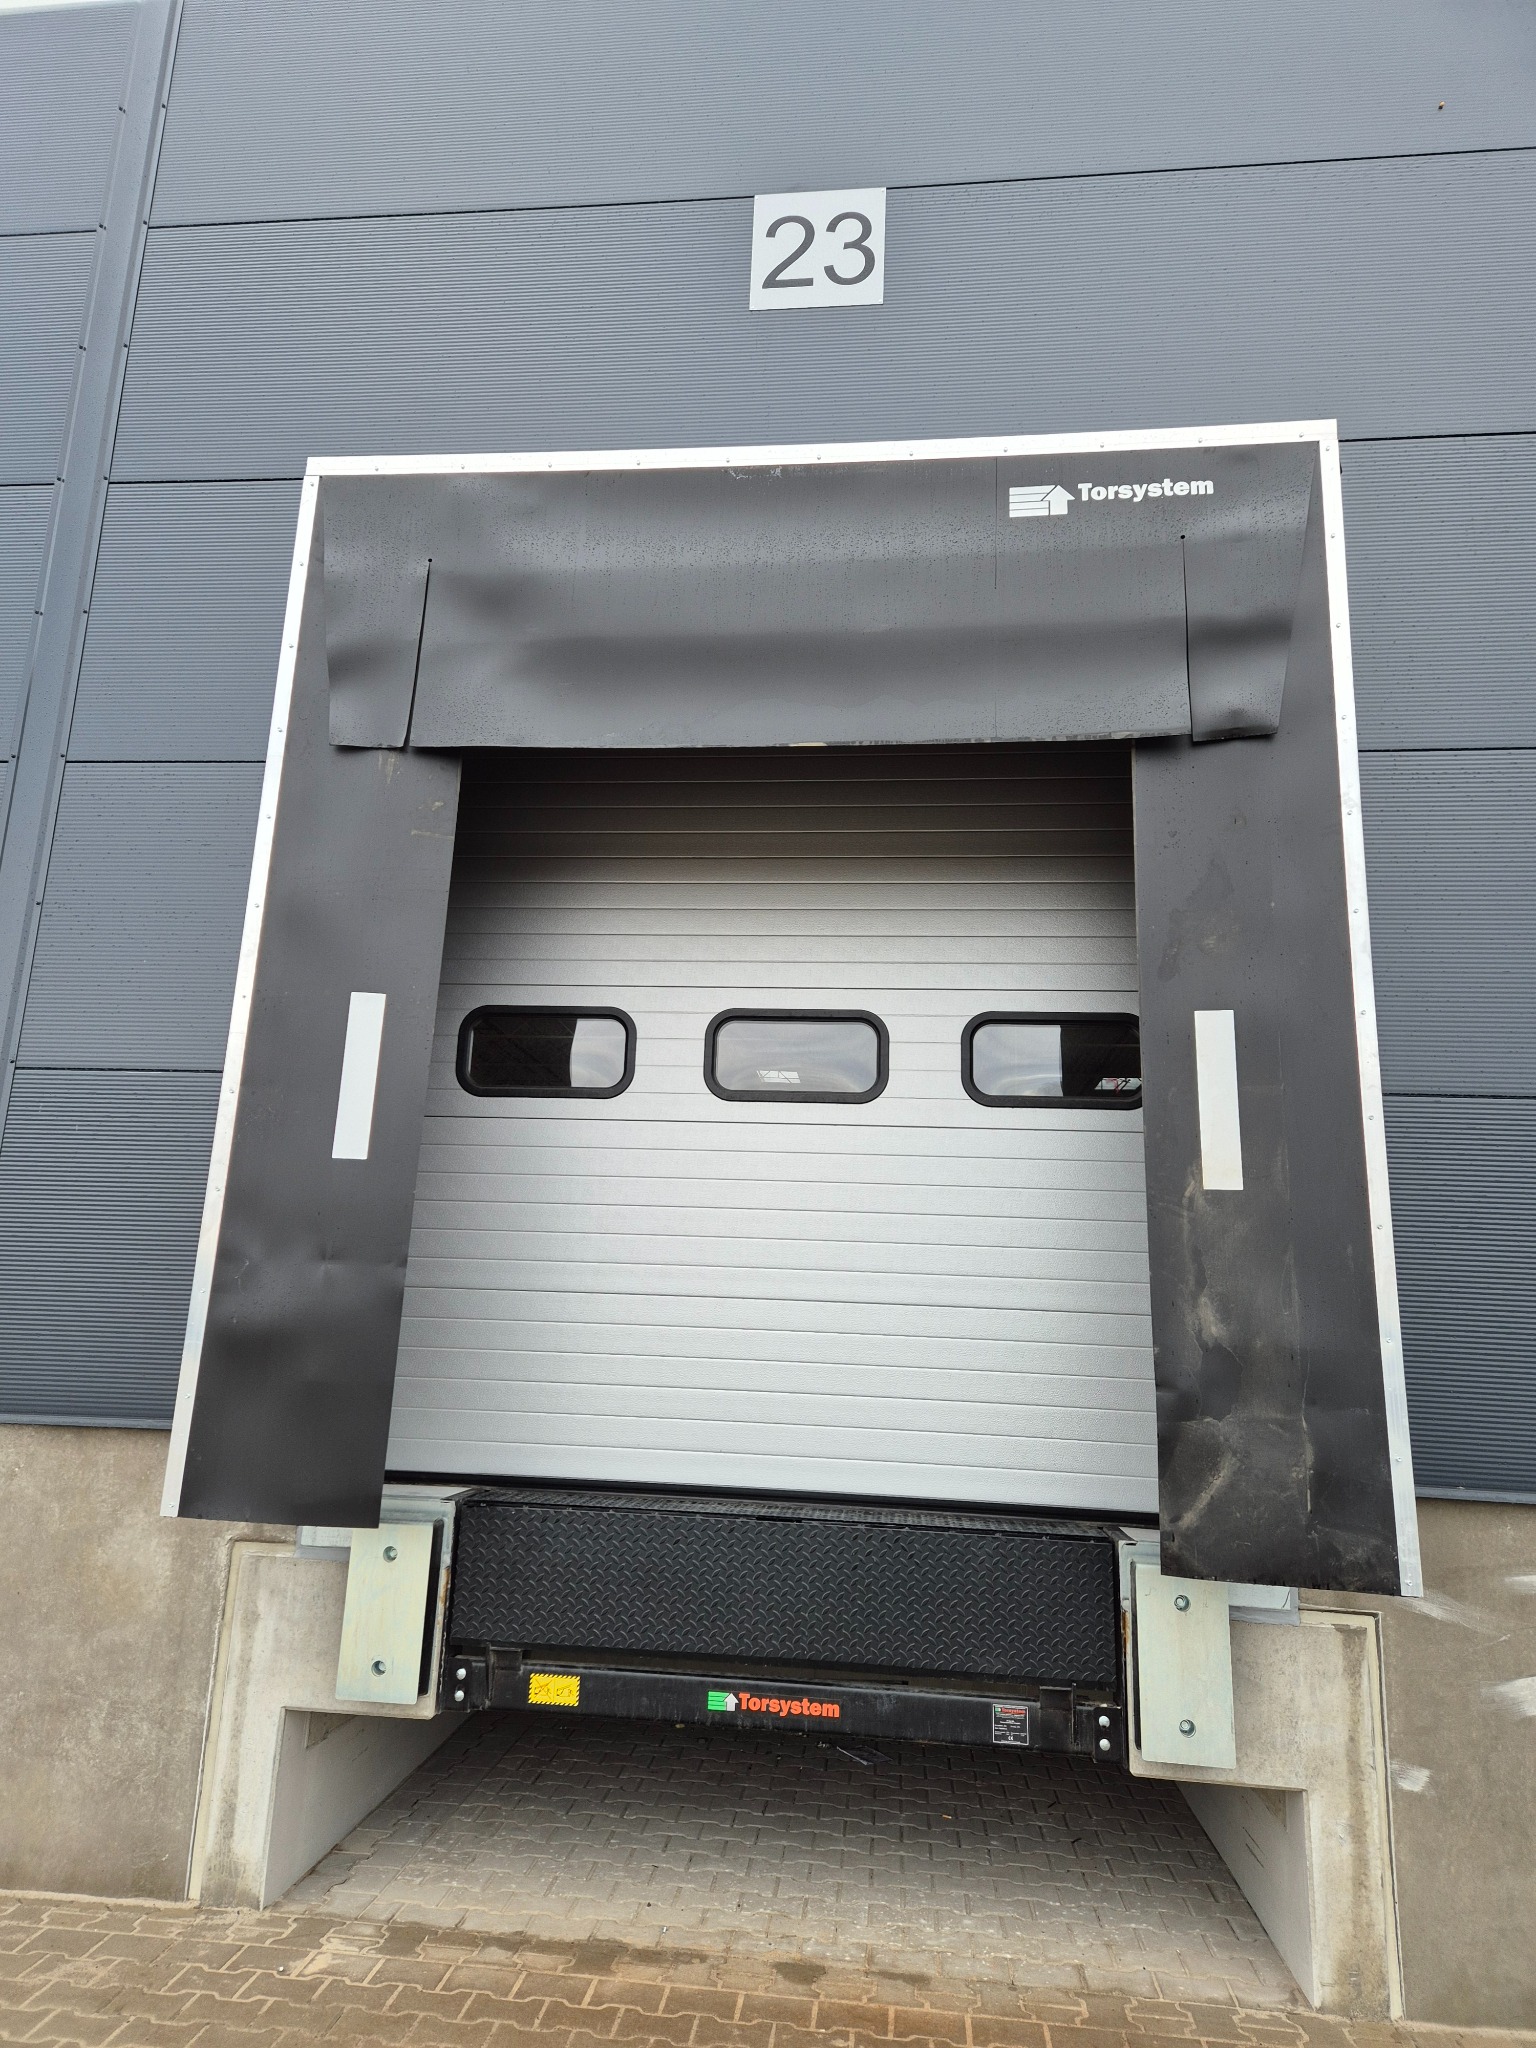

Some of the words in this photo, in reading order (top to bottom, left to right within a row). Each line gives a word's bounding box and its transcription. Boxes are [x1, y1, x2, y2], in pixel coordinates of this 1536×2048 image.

[762, 211, 875, 289] 23
[1078, 478, 1214, 502] Torsystem
[739, 1692, 840, 1717] Torsystem
